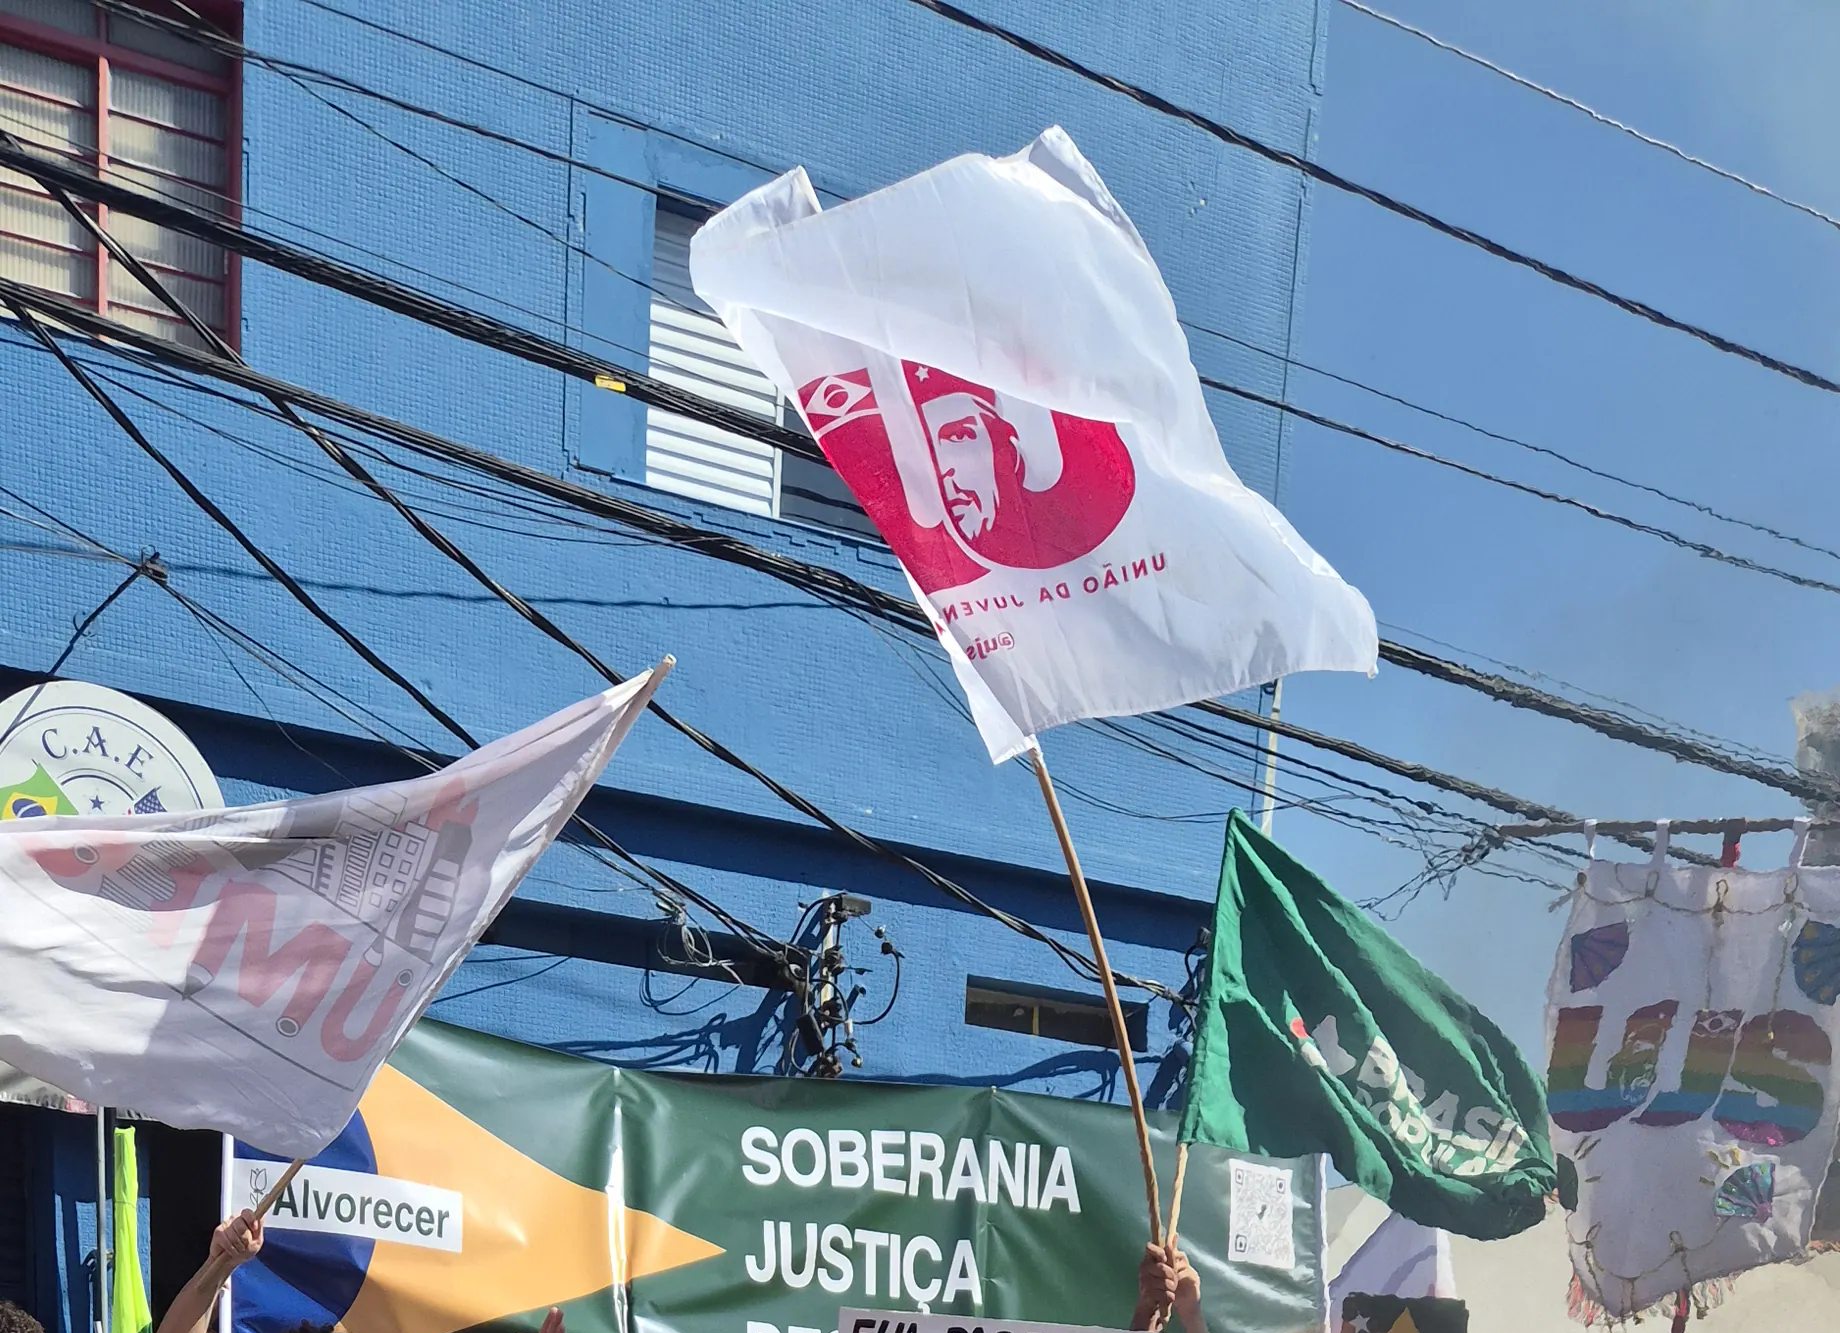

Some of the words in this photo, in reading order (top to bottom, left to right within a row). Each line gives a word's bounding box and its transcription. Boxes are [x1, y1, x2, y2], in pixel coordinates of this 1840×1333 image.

[272, 1178, 450, 1239] Alvorecer
[741, 1125, 1081, 1214] SOBERANIA
[745, 1219, 984, 1316] JUSTIÇA
